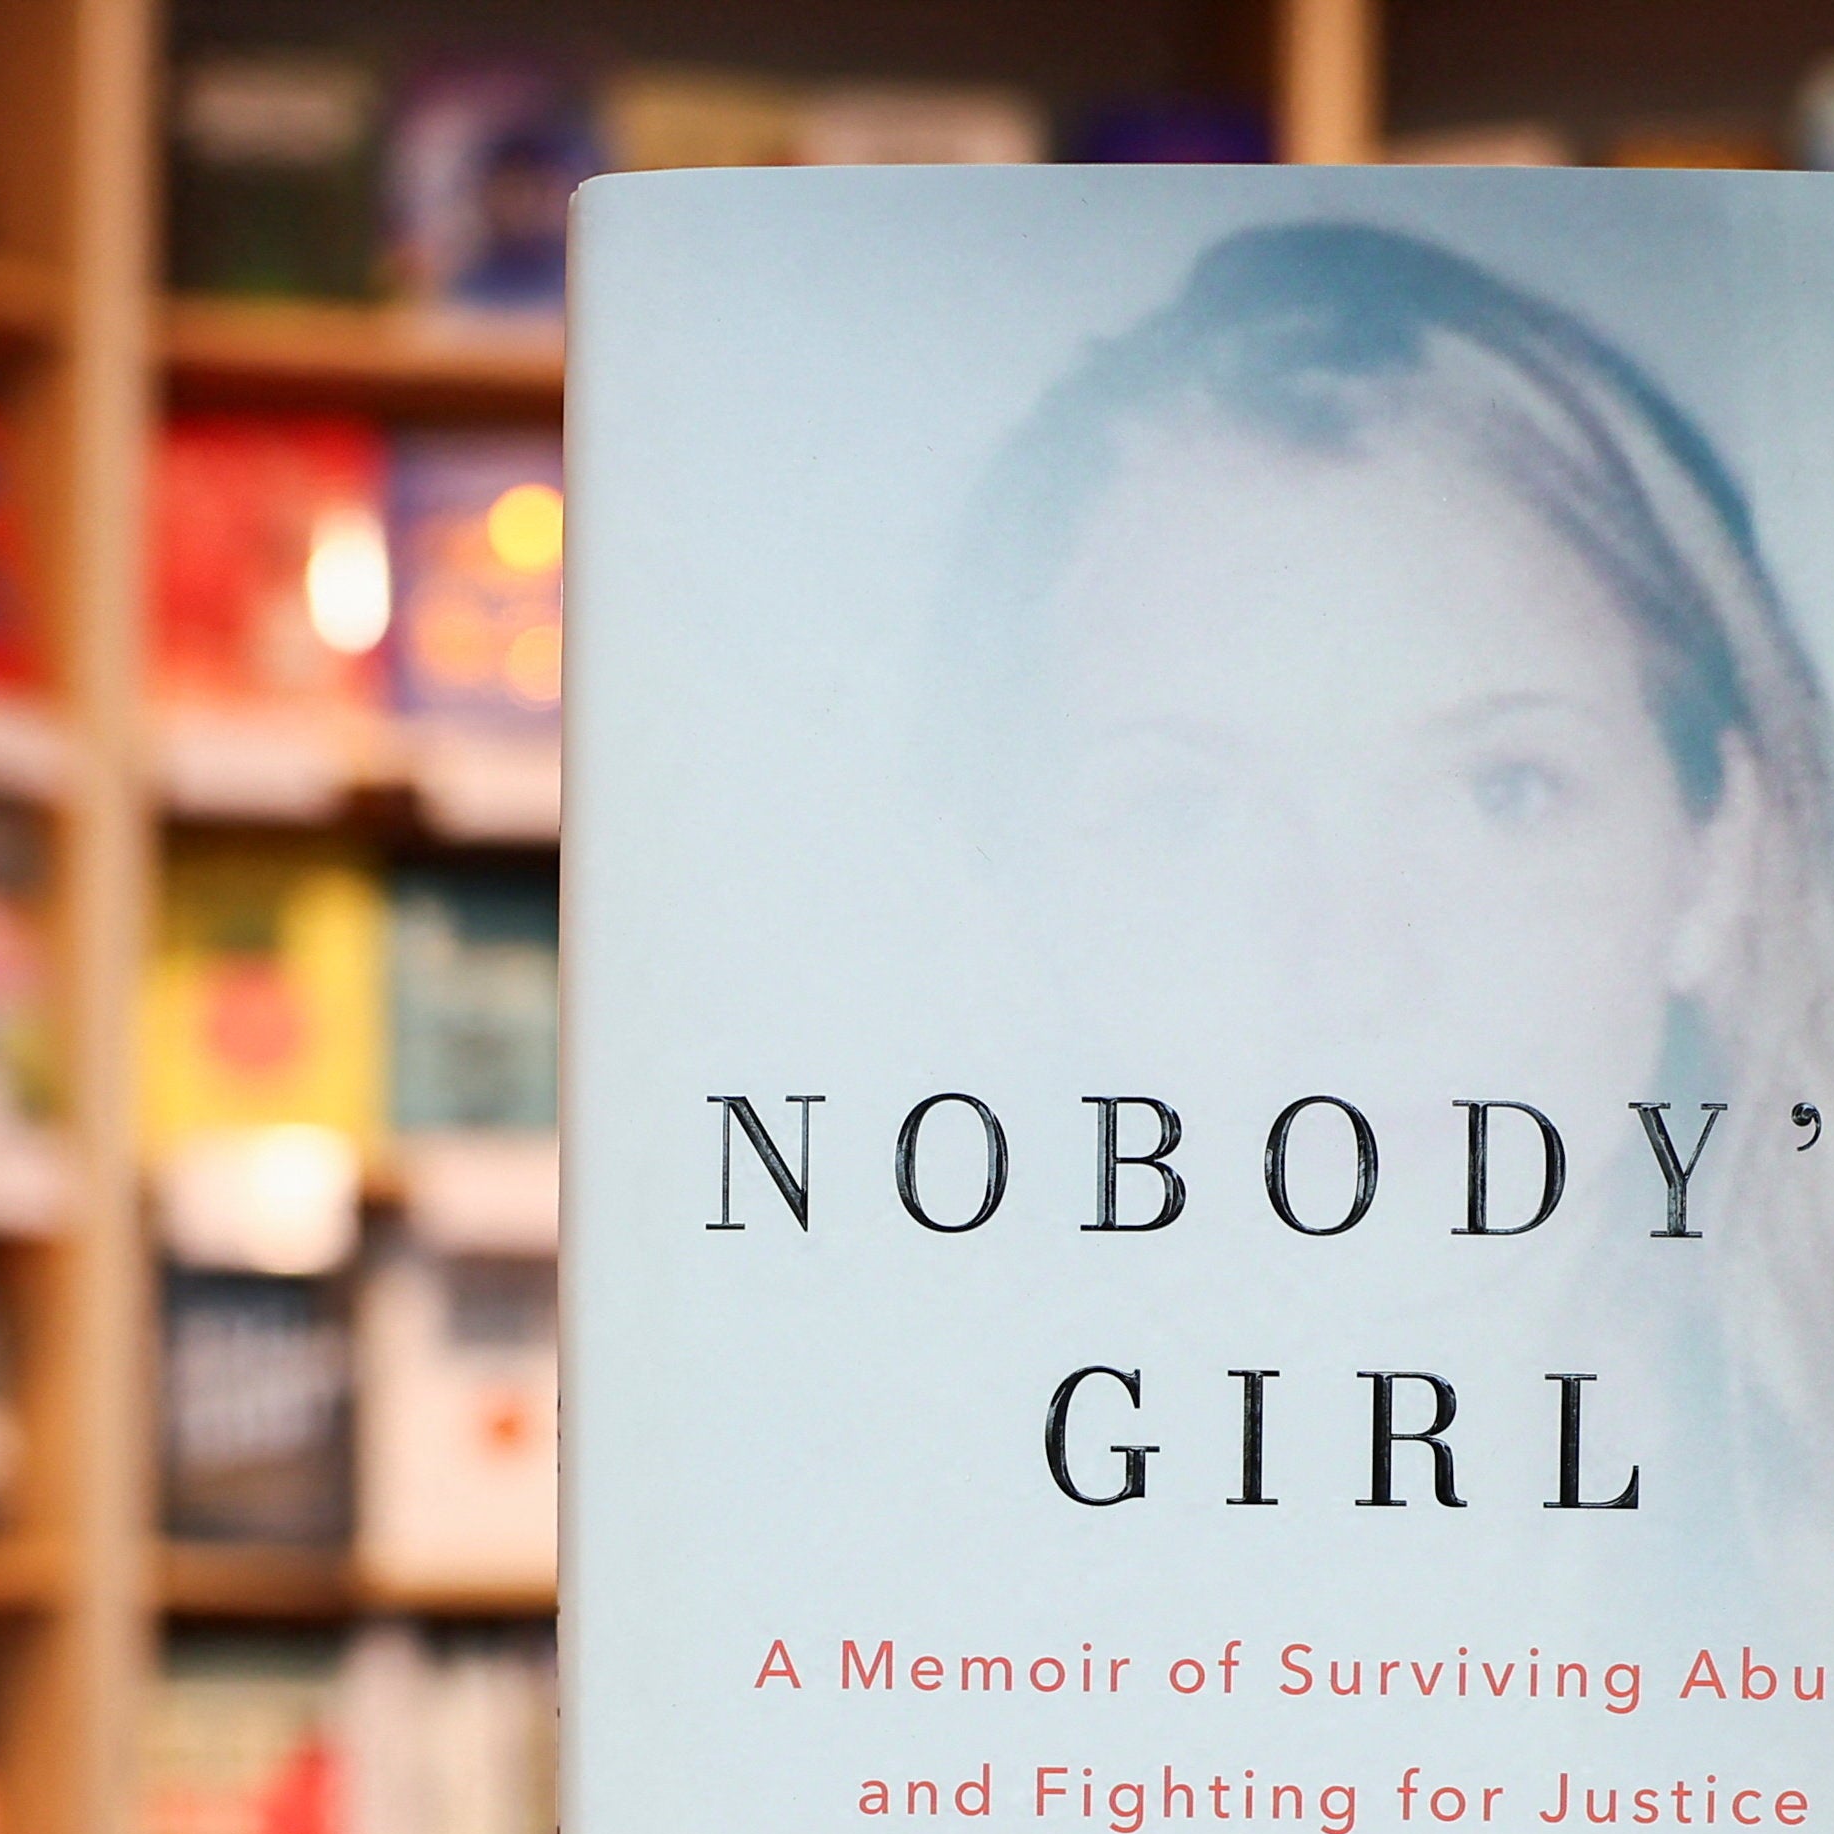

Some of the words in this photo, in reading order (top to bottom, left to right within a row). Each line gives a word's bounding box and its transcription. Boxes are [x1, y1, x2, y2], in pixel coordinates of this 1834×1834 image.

[1045, 1366, 1641, 1510] GIRL
[754, 1639, 802, 1690] A
[841, 1639, 1132, 1694] Memoir
[1169, 1640, 1242, 1694] of
[1278, 1644, 1643, 1713] Surviving
[858, 1763, 992, 1818] and
[1397, 1768, 1504, 1823] for
[1539, 1772, 1812, 1828] Justice
